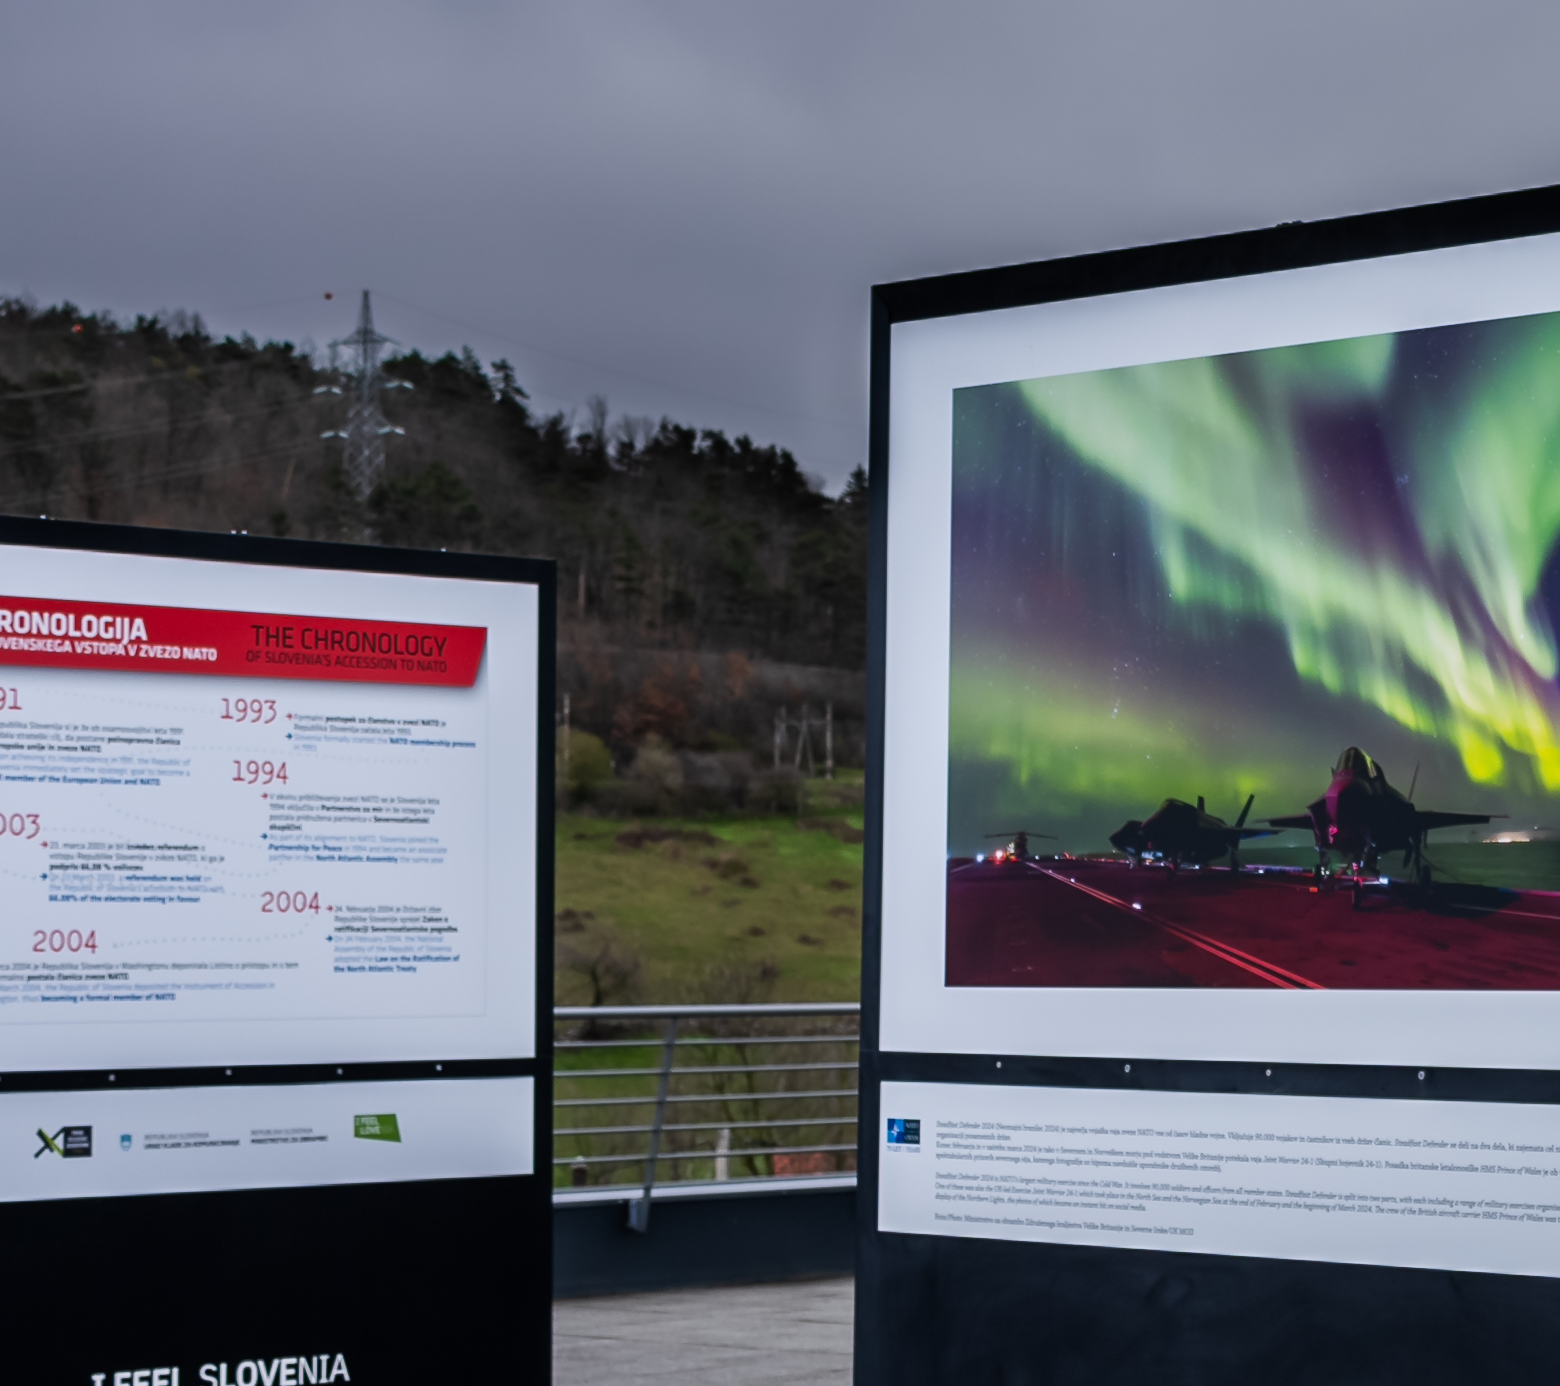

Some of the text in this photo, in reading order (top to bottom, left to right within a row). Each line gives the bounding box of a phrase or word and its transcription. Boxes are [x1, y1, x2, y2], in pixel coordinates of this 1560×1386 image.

[74, 641, 126, 657] VSTOPA
[127, 644, 139, 657] V
[139, 644, 181, 659] ZVEZO
[182, 646, 217, 661] NATO
[251, 625, 447, 657] THE CHRONOLOGY
[246, 650, 447, 673] OF SLOVENIA'S ACCESSION TO NATO
[220, 698, 277, 724] 1993
[232, 760, 289, 785] 1994
[260, 891, 321, 914] 2004
[32, 929, 98, 954] 2004
